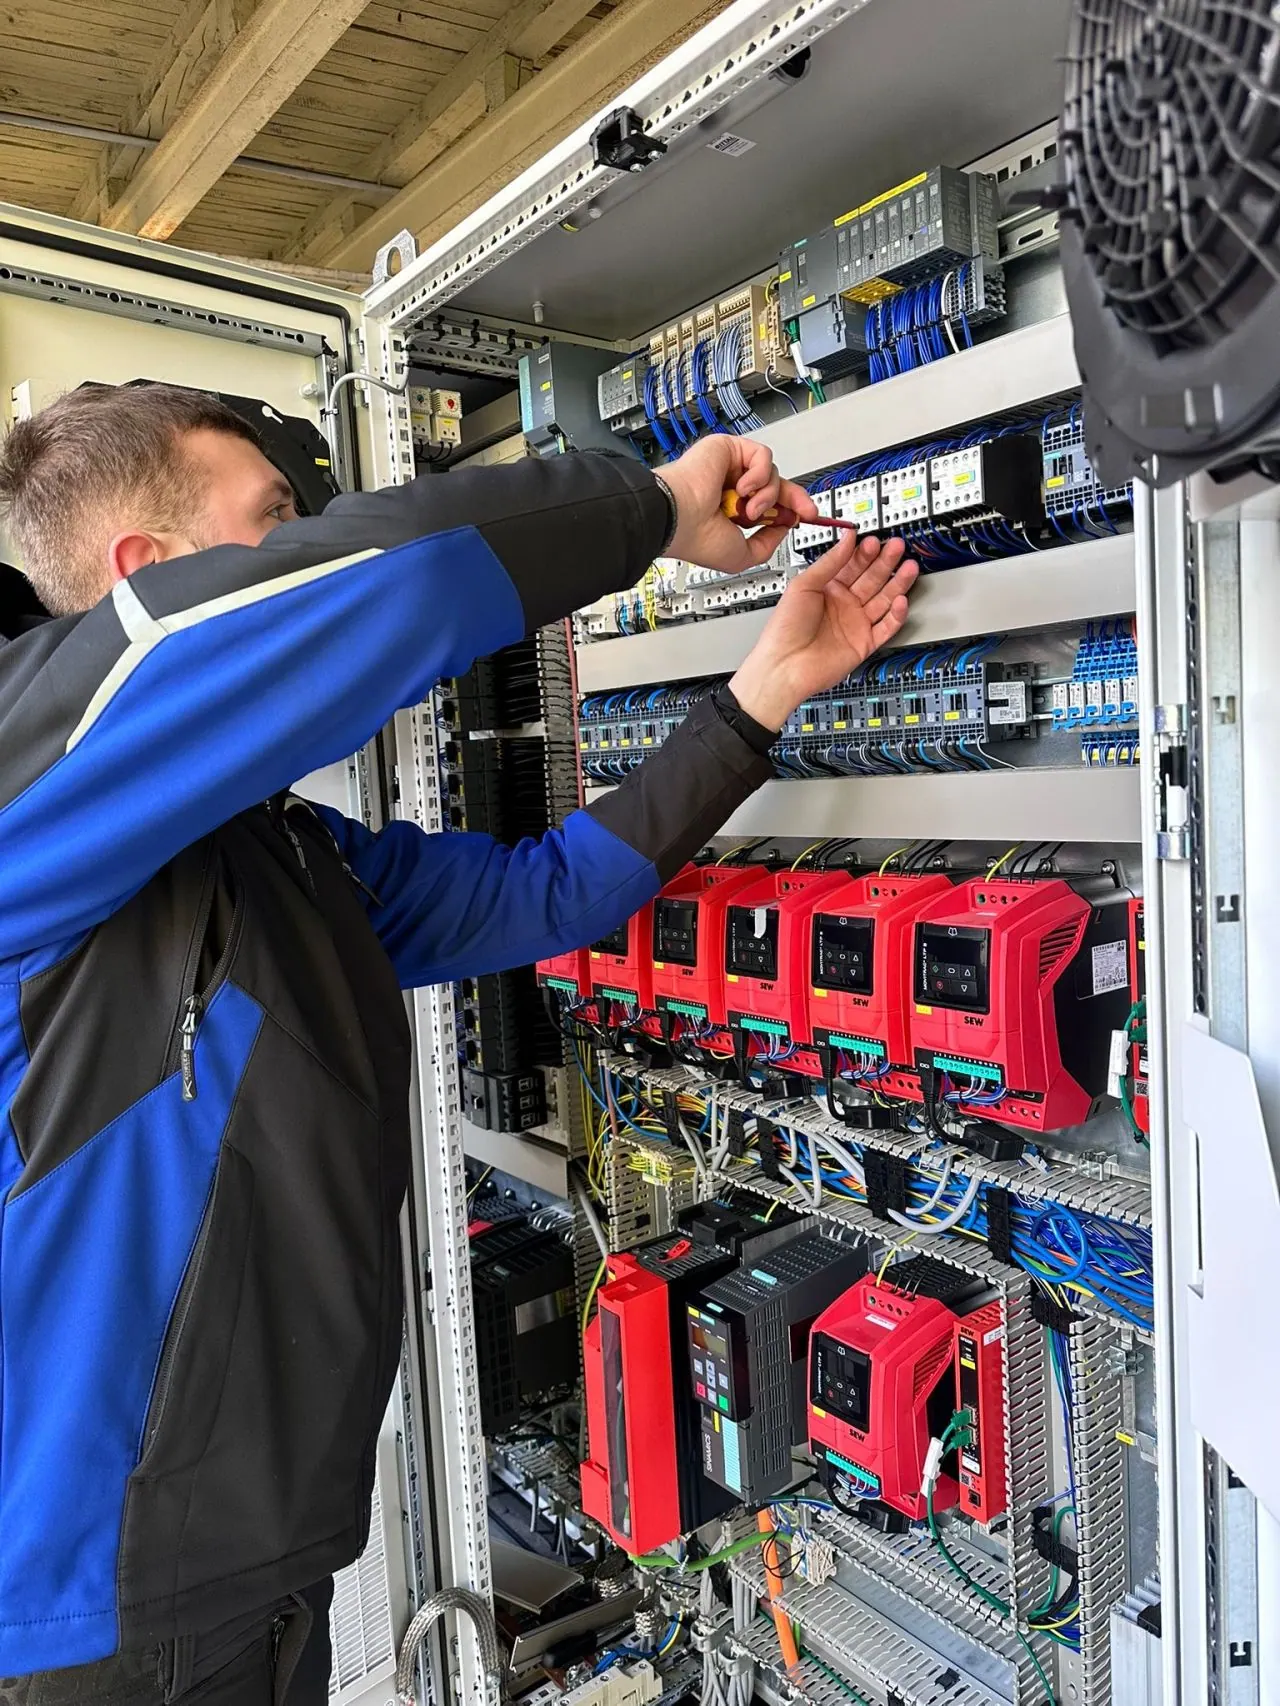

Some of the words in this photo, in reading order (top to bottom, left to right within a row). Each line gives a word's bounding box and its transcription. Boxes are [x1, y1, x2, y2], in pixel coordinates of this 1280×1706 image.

[760, 982, 774, 991] SEW
[852, 997, 869, 1007] SEW
[964, 1016, 984, 1027] SEW
[849, 1428, 865, 1442] SEW
